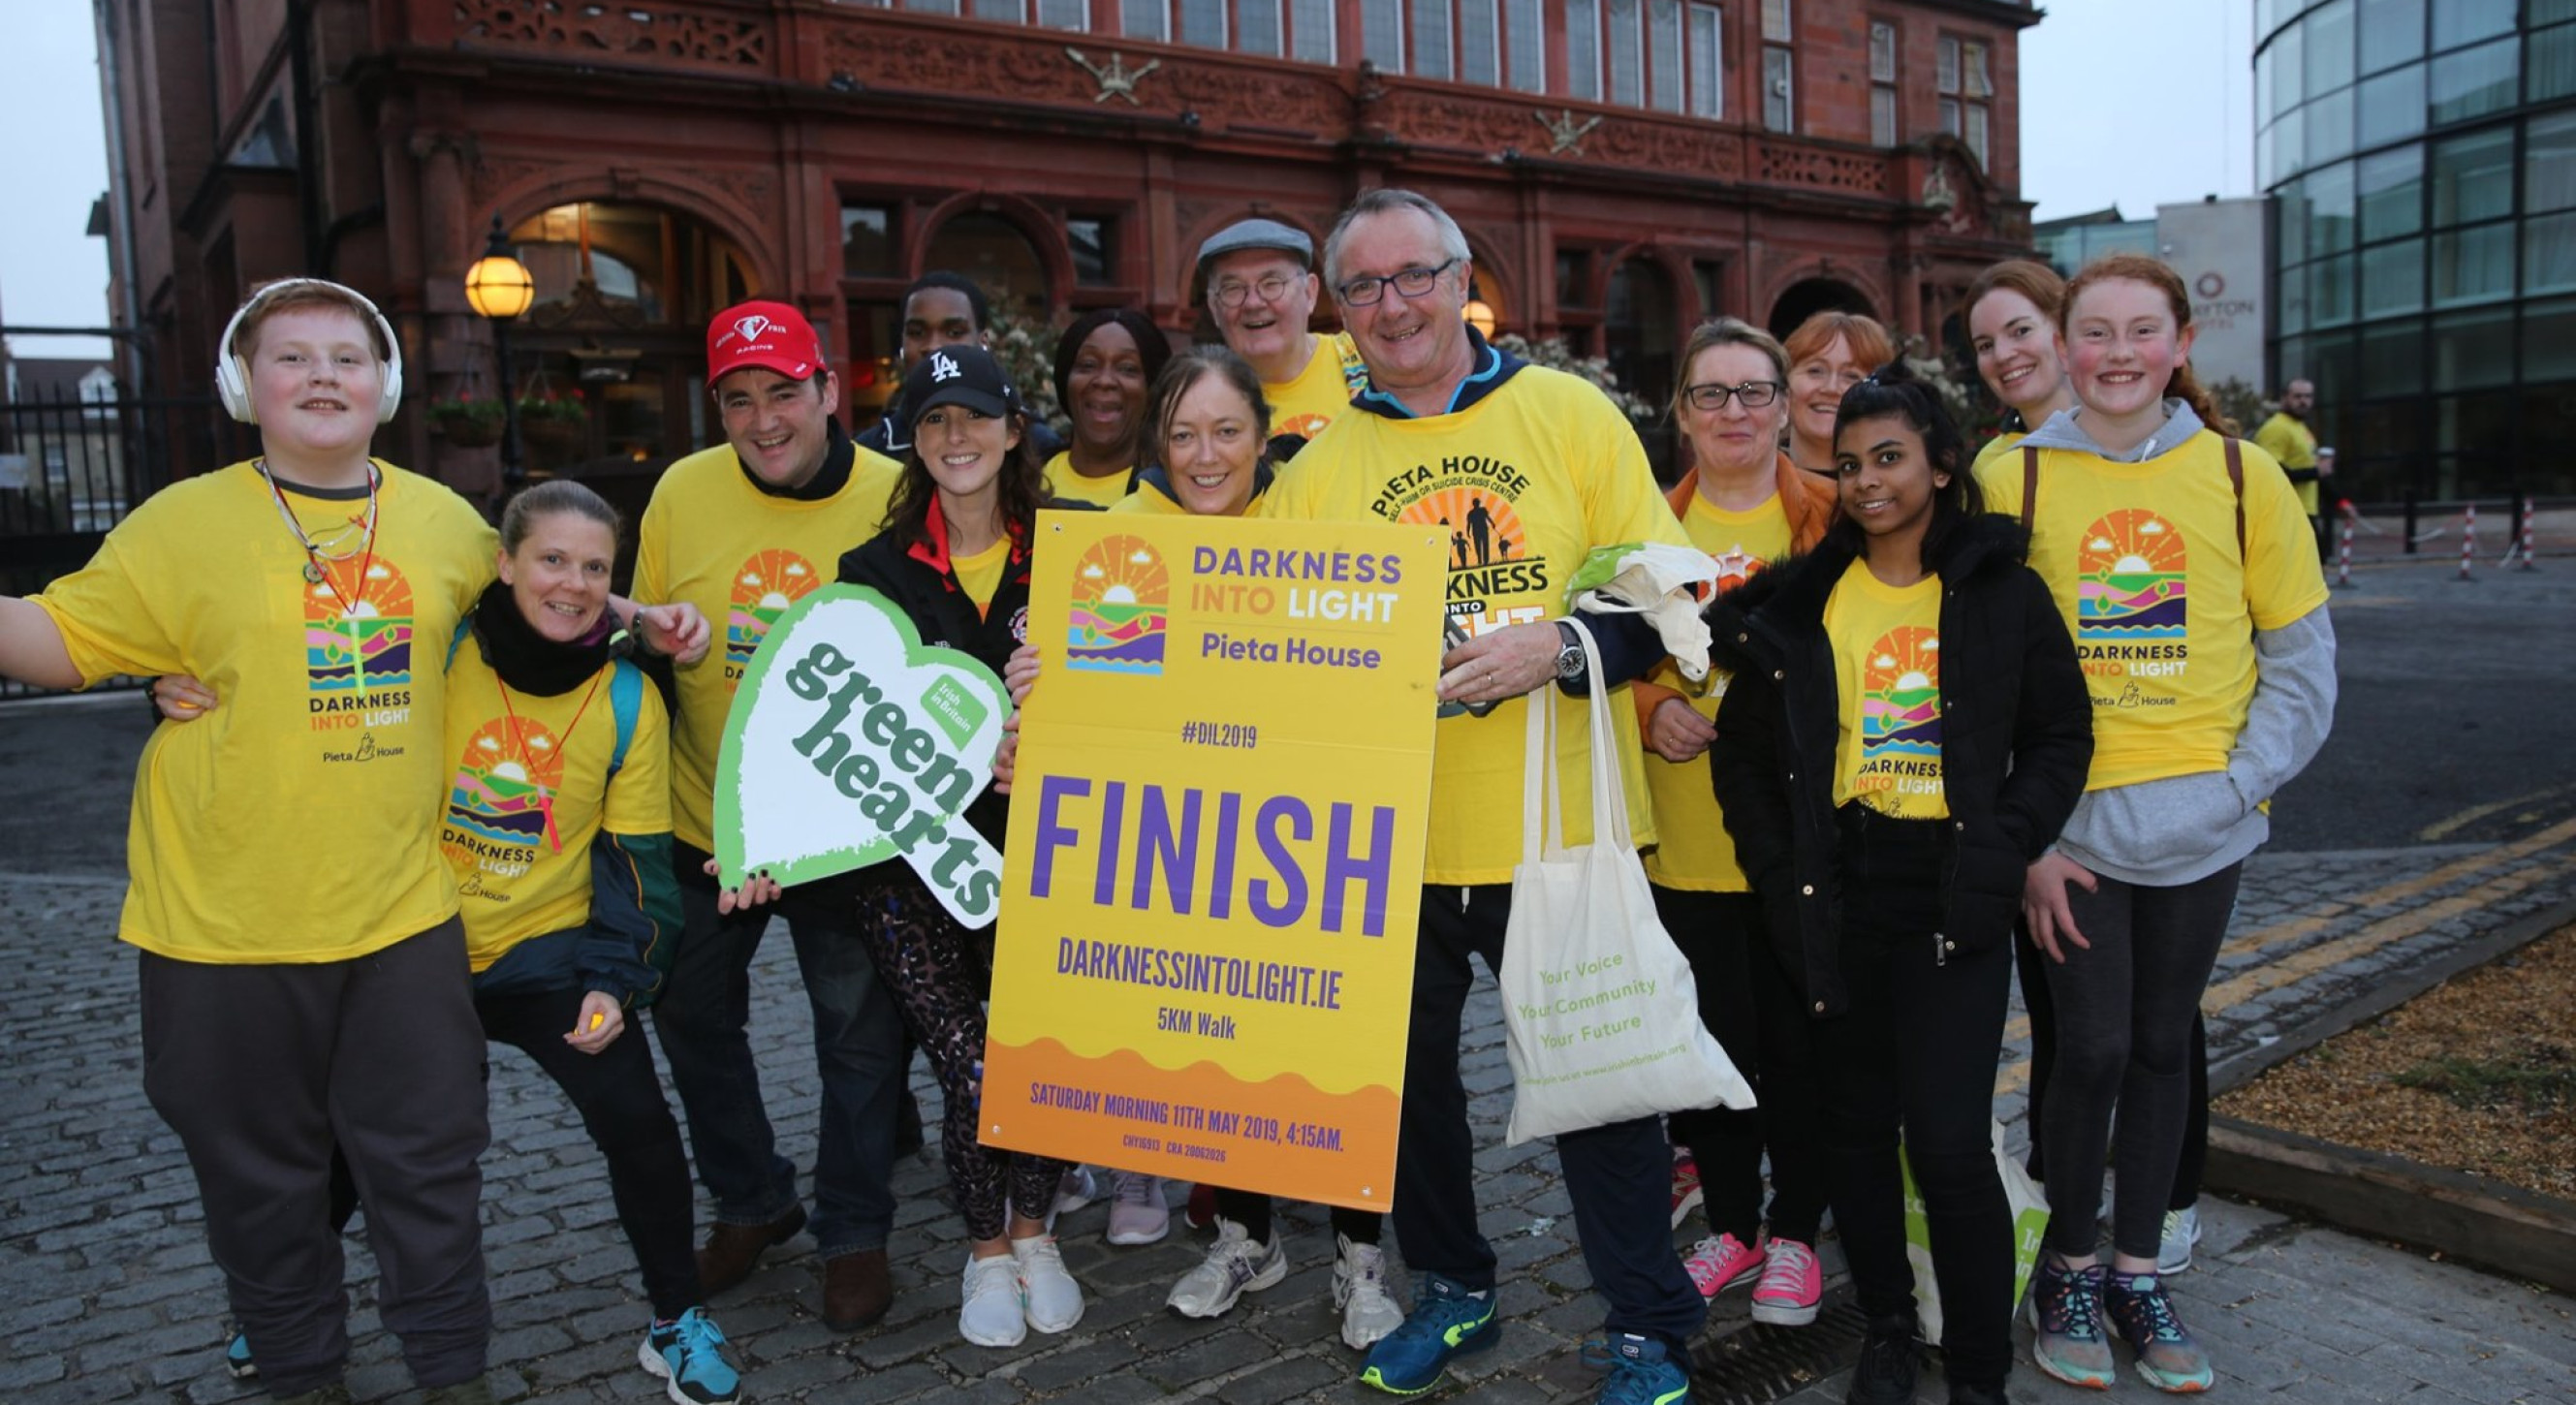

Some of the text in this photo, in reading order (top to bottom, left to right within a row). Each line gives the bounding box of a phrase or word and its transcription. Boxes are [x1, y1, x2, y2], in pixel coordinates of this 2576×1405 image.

[930, 351, 962, 383] LA
[1371, 455, 1530, 516] PIETA HOUSE
[1419, 484, 1432, 496] OR
[1431, 476, 1463, 490] SUICIDE
[1464, 476, 1492, 488] CRISIS
[1490, 481, 1519, 504] CENTRE
[1193, 546, 1401, 584] DARKNESS
[1446, 563, 1549, 600] KNESS
[1191, 582, 1398, 622] INTO LIGHT
[1445, 602, 1481, 614] INTO
[1202, 632, 1381, 669] Pieta House
[2077, 644, 2187, 660] DARKNESS
[2083, 661, 2187, 676] NTO LIGHT
[309, 691, 411, 713] DARKNESS
[939, 683, 960, 705] Irish
[2141, 696, 2176, 706] House
[311, 708, 411, 732] INTO LIGHT
[785, 641, 974, 816] green
[930, 692, 971, 733] in Britain
[1181, 721, 1258, 748] #DIL2019
[323, 747, 404, 763] Pieta House
[792, 692, 1001, 916] hearts
[442, 828, 535, 863] DARKNESS
[1030, 774, 1396, 938] FINISH
[480, 890, 512, 902] House
[1057, 937, 1344, 1010] DARKNESSINTOLIGHT.IE
[1539, 954, 1623, 984] Your Voice
[1519, 979, 1656, 1019] Your Community
[1157, 1007, 1237, 1040] 5KM Walk
[1540, 1016, 1641, 1048] Your Future
[1030, 1081, 1344, 1152] SATURDAY MORNING 11TH MAY 2019, 4:15AM.
[1167, 1141, 1183, 1156] CRA
